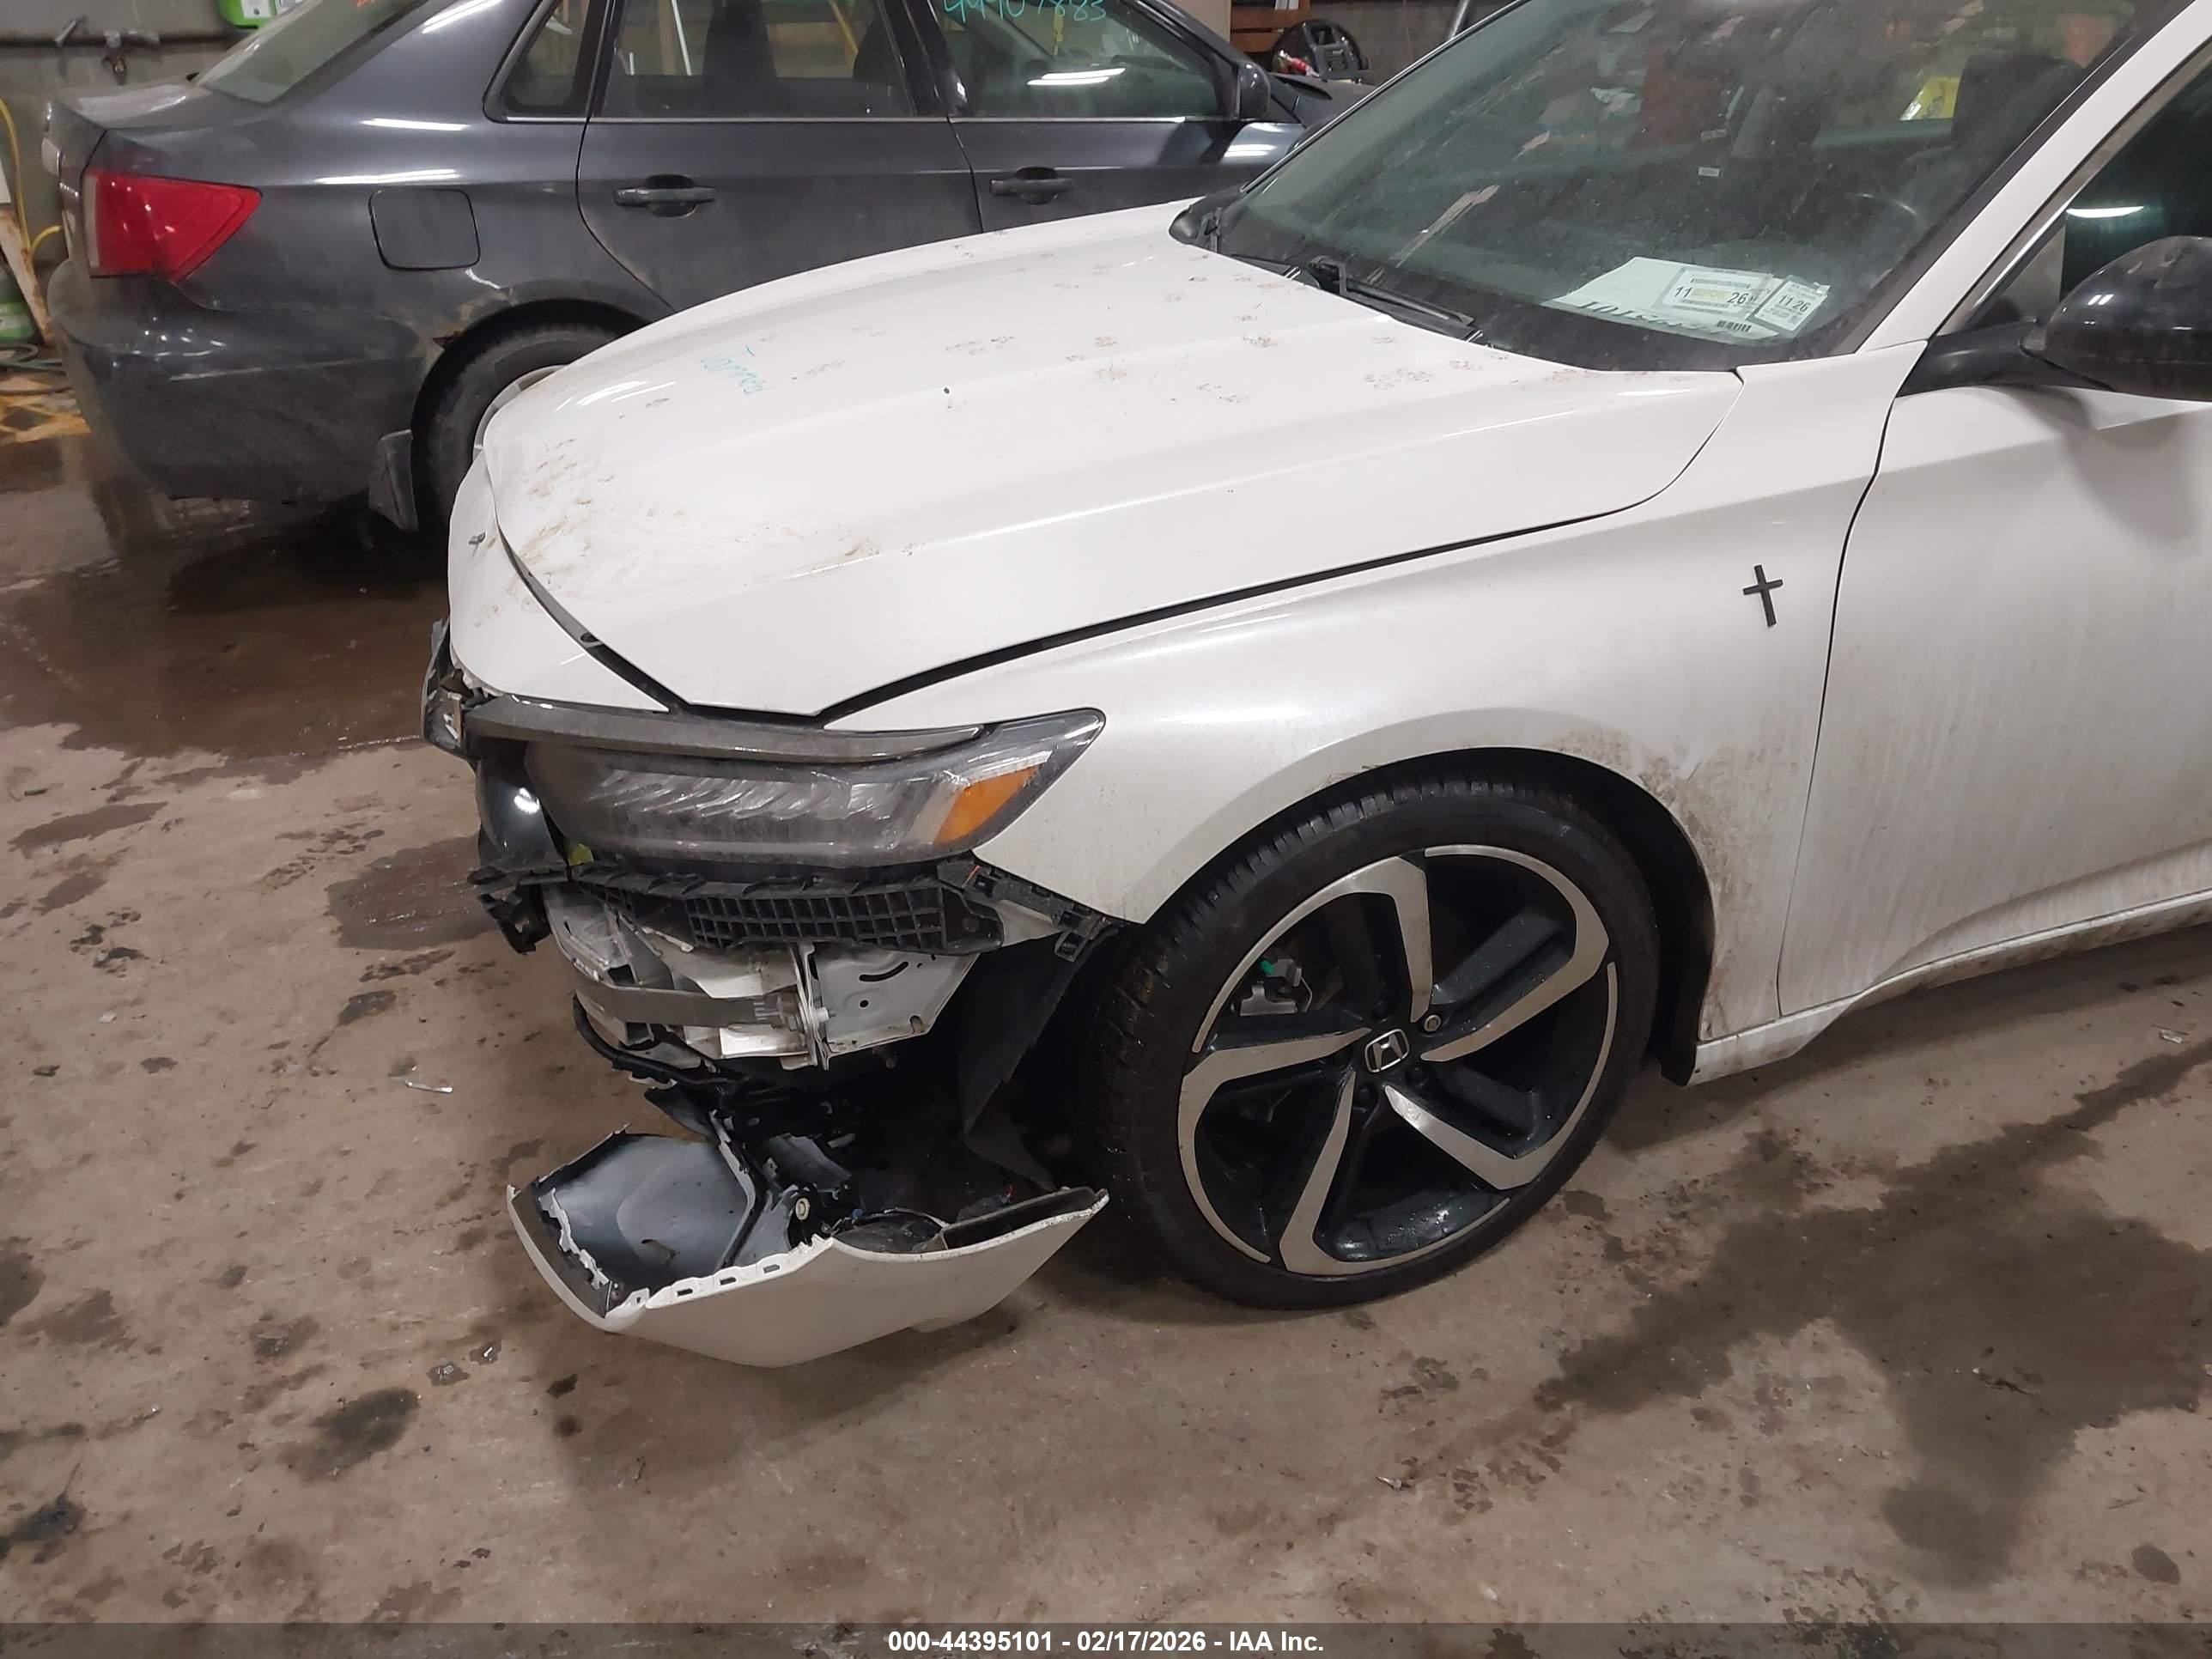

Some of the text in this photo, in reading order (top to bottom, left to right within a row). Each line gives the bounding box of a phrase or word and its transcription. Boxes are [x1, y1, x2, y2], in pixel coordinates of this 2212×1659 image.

[1674, 285, 1693, 298] 11
[1727, 291, 1749, 305] 26
[1778, 295, 1794, 307] 11
[1793, 300, 1811, 313] 26
